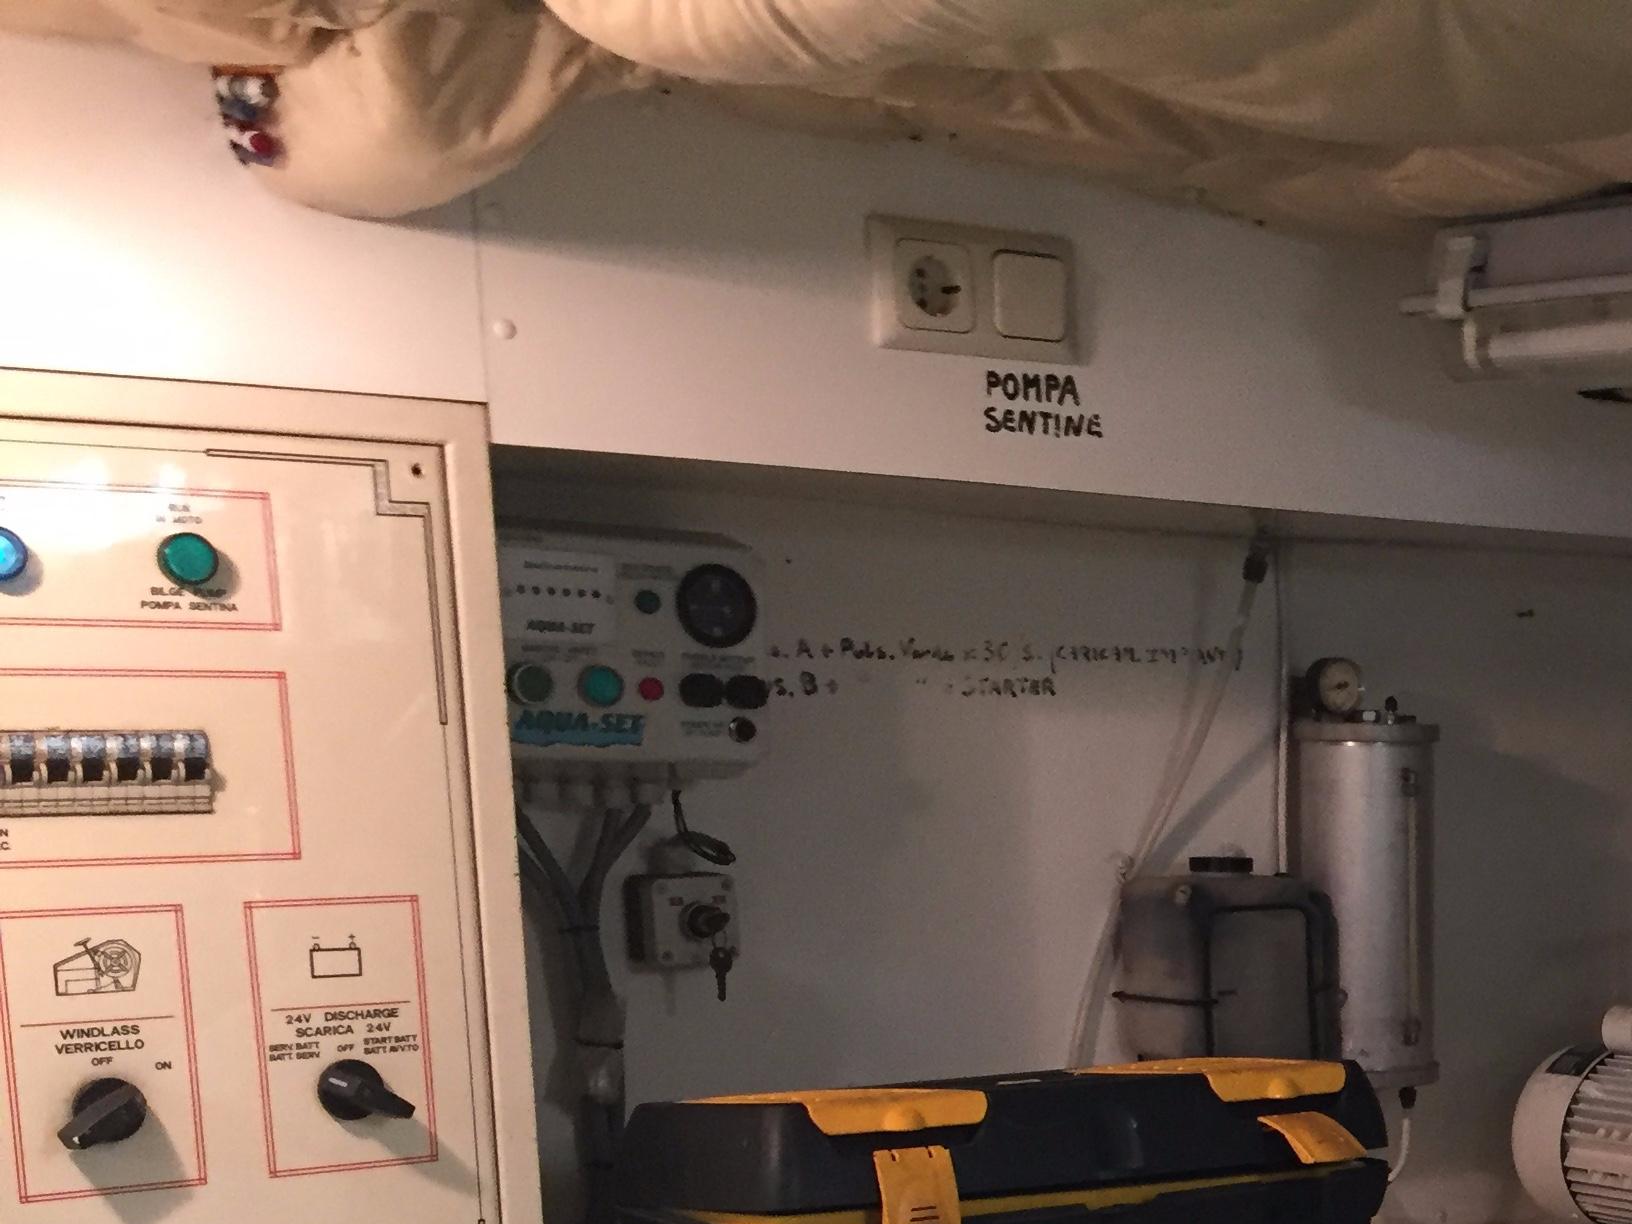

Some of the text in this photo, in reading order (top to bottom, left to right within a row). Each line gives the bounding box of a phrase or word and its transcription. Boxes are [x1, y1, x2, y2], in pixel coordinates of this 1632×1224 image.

[985, 369, 1081, 406] POMPA
[983, 406, 1104, 439] SENTINE
[140, 600, 239, 613] POMPA SENTINA
[285, 1007, 400, 1025] 24V DISCHARGE
[59, 1024, 141, 1041] WINDLASS
[295, 1022, 392, 1038] SCARICA 24V
[54, 1038, 146, 1056] VERRICELLO
[337, 1044, 355, 1053] OFF
[90, 1055, 115, 1068] OFF
[154, 1060, 173, 1071] ON
